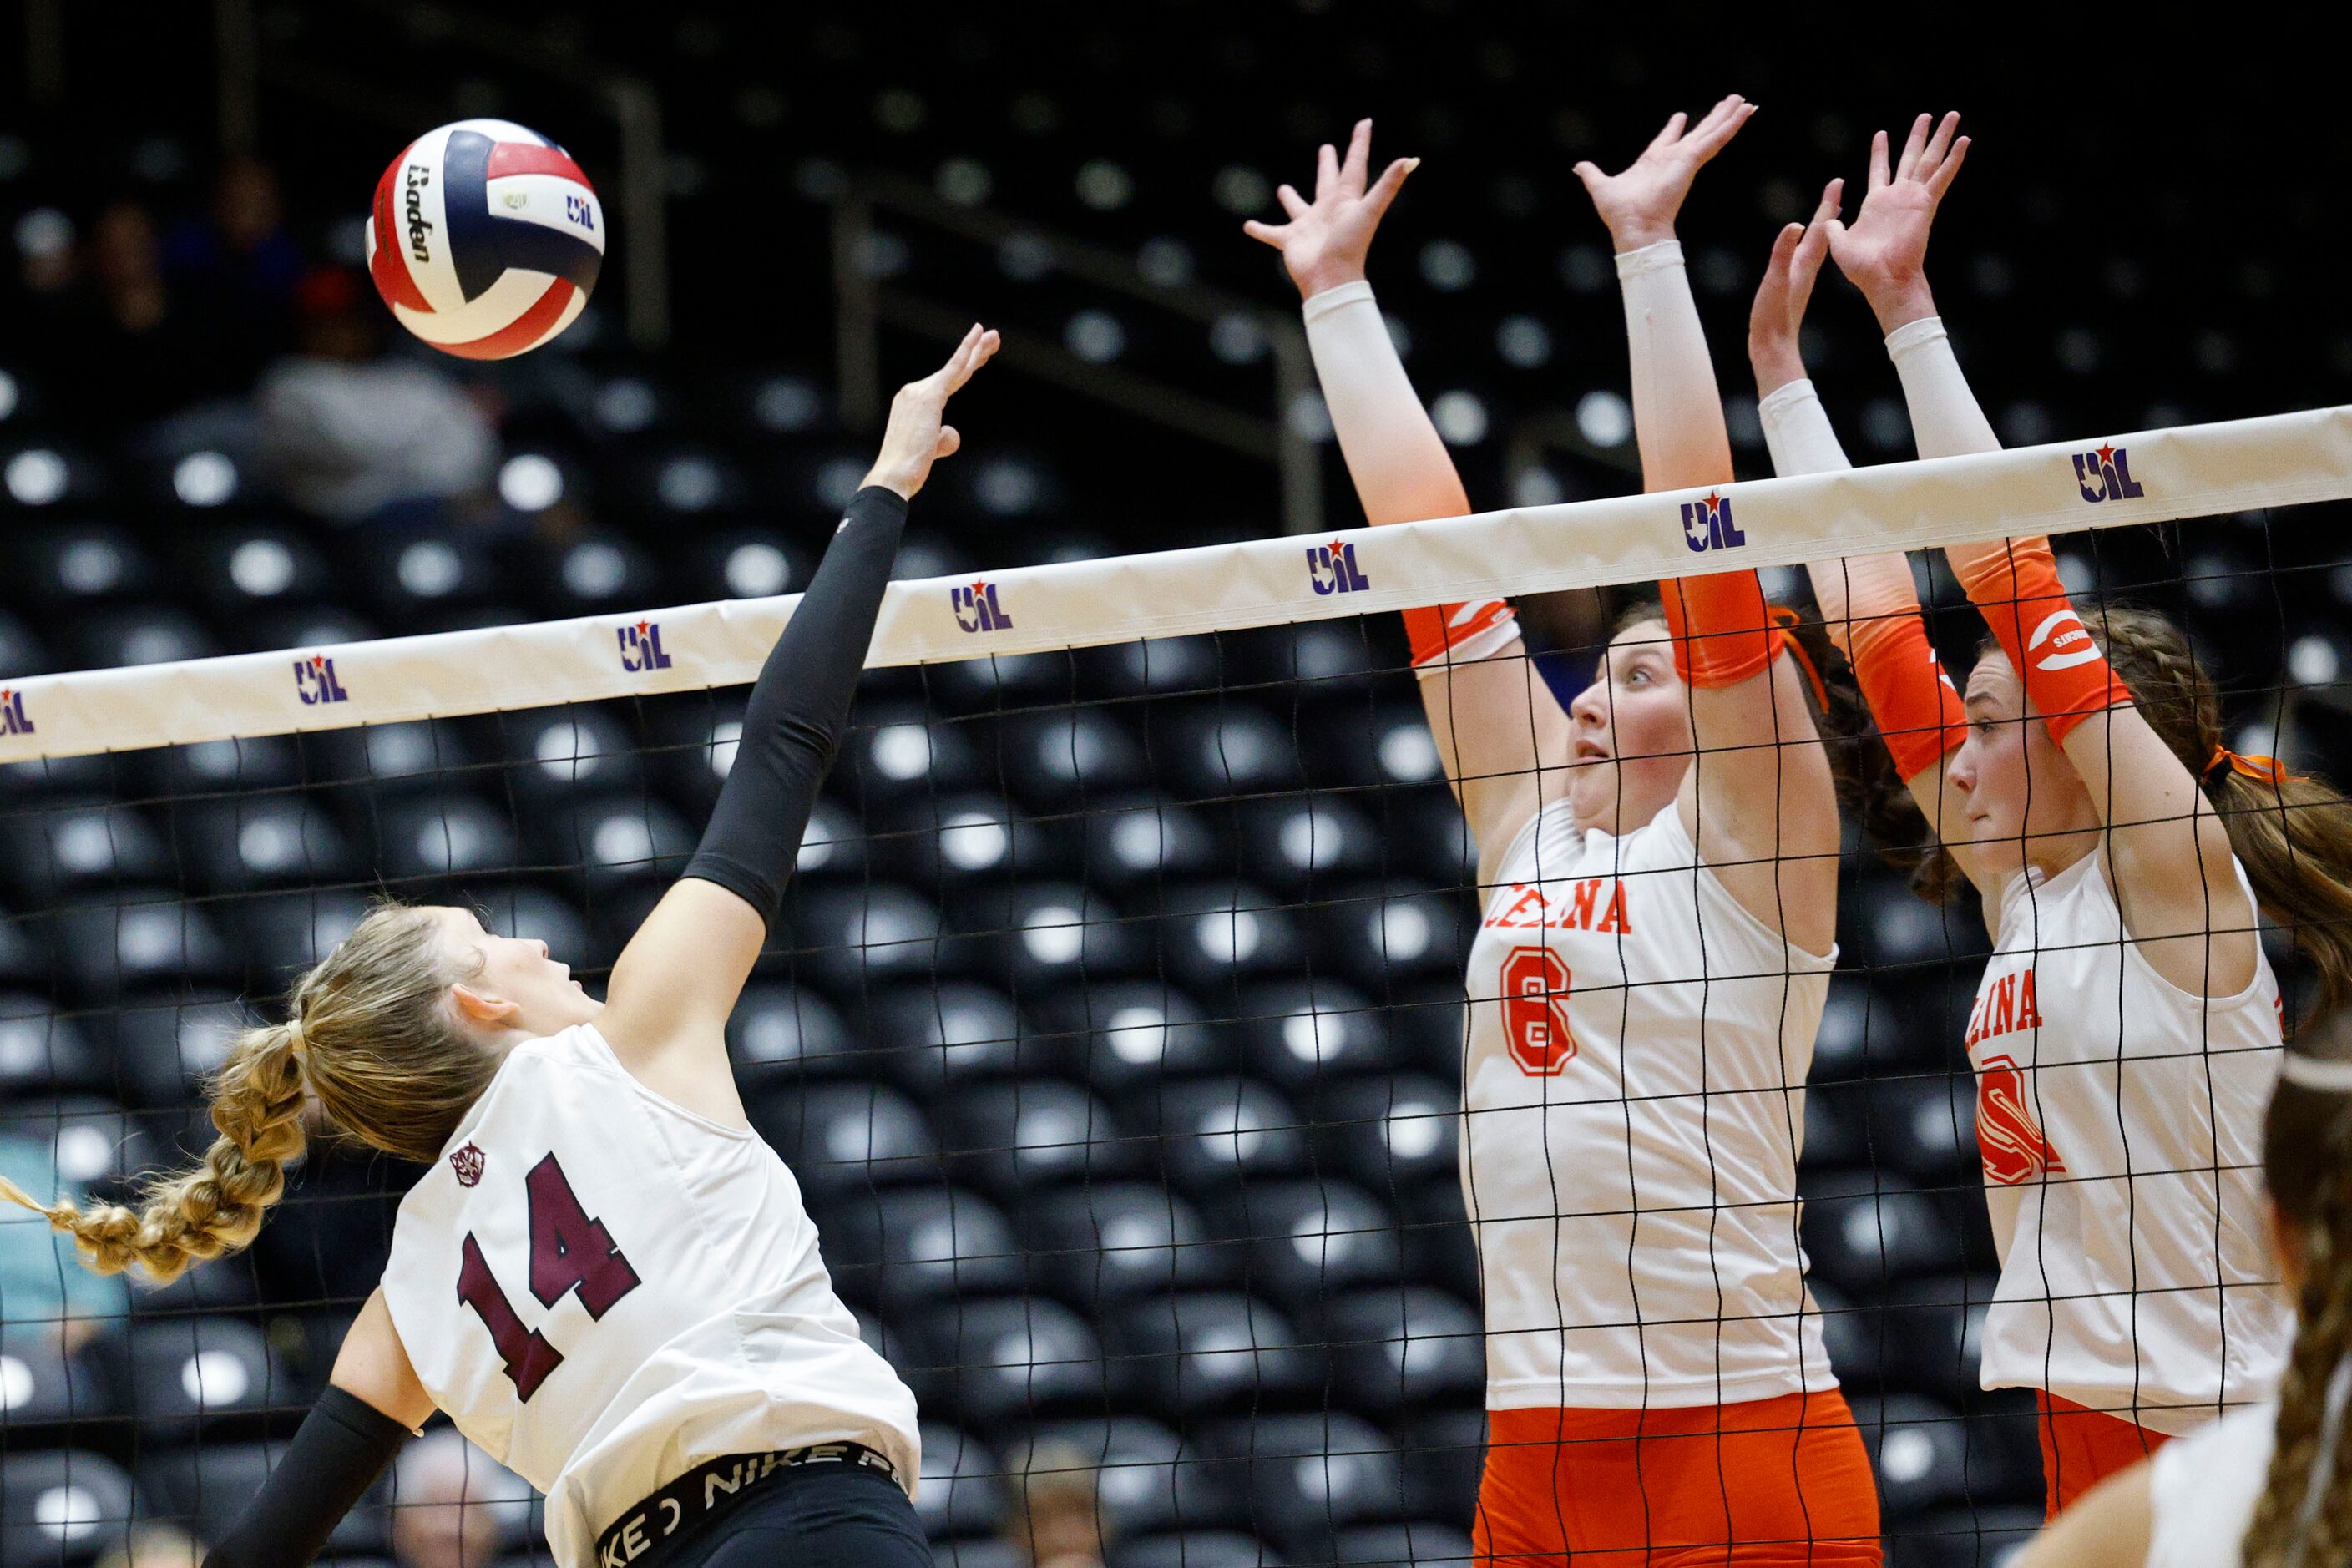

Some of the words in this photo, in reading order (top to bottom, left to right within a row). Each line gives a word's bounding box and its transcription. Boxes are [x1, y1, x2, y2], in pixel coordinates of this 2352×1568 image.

[406, 164, 432, 264] Baden
[567, 195, 594, 231] UIL
[2072, 441, 2144, 503] UIL
[1681, 491, 1746, 552] UIL
[1306, 538, 1369, 594] UIL
[950, 579, 1014, 633] UIL
[618, 619, 671, 672] UIL
[2052, 629, 2090, 648] CATS
[295, 655, 348, 706] UIL
[0, 689, 34, 735] IL
[1500, 946, 1578, 1077] 6
[457, 1150, 642, 1404] 14
[601, 1513, 651, 1568] KE
